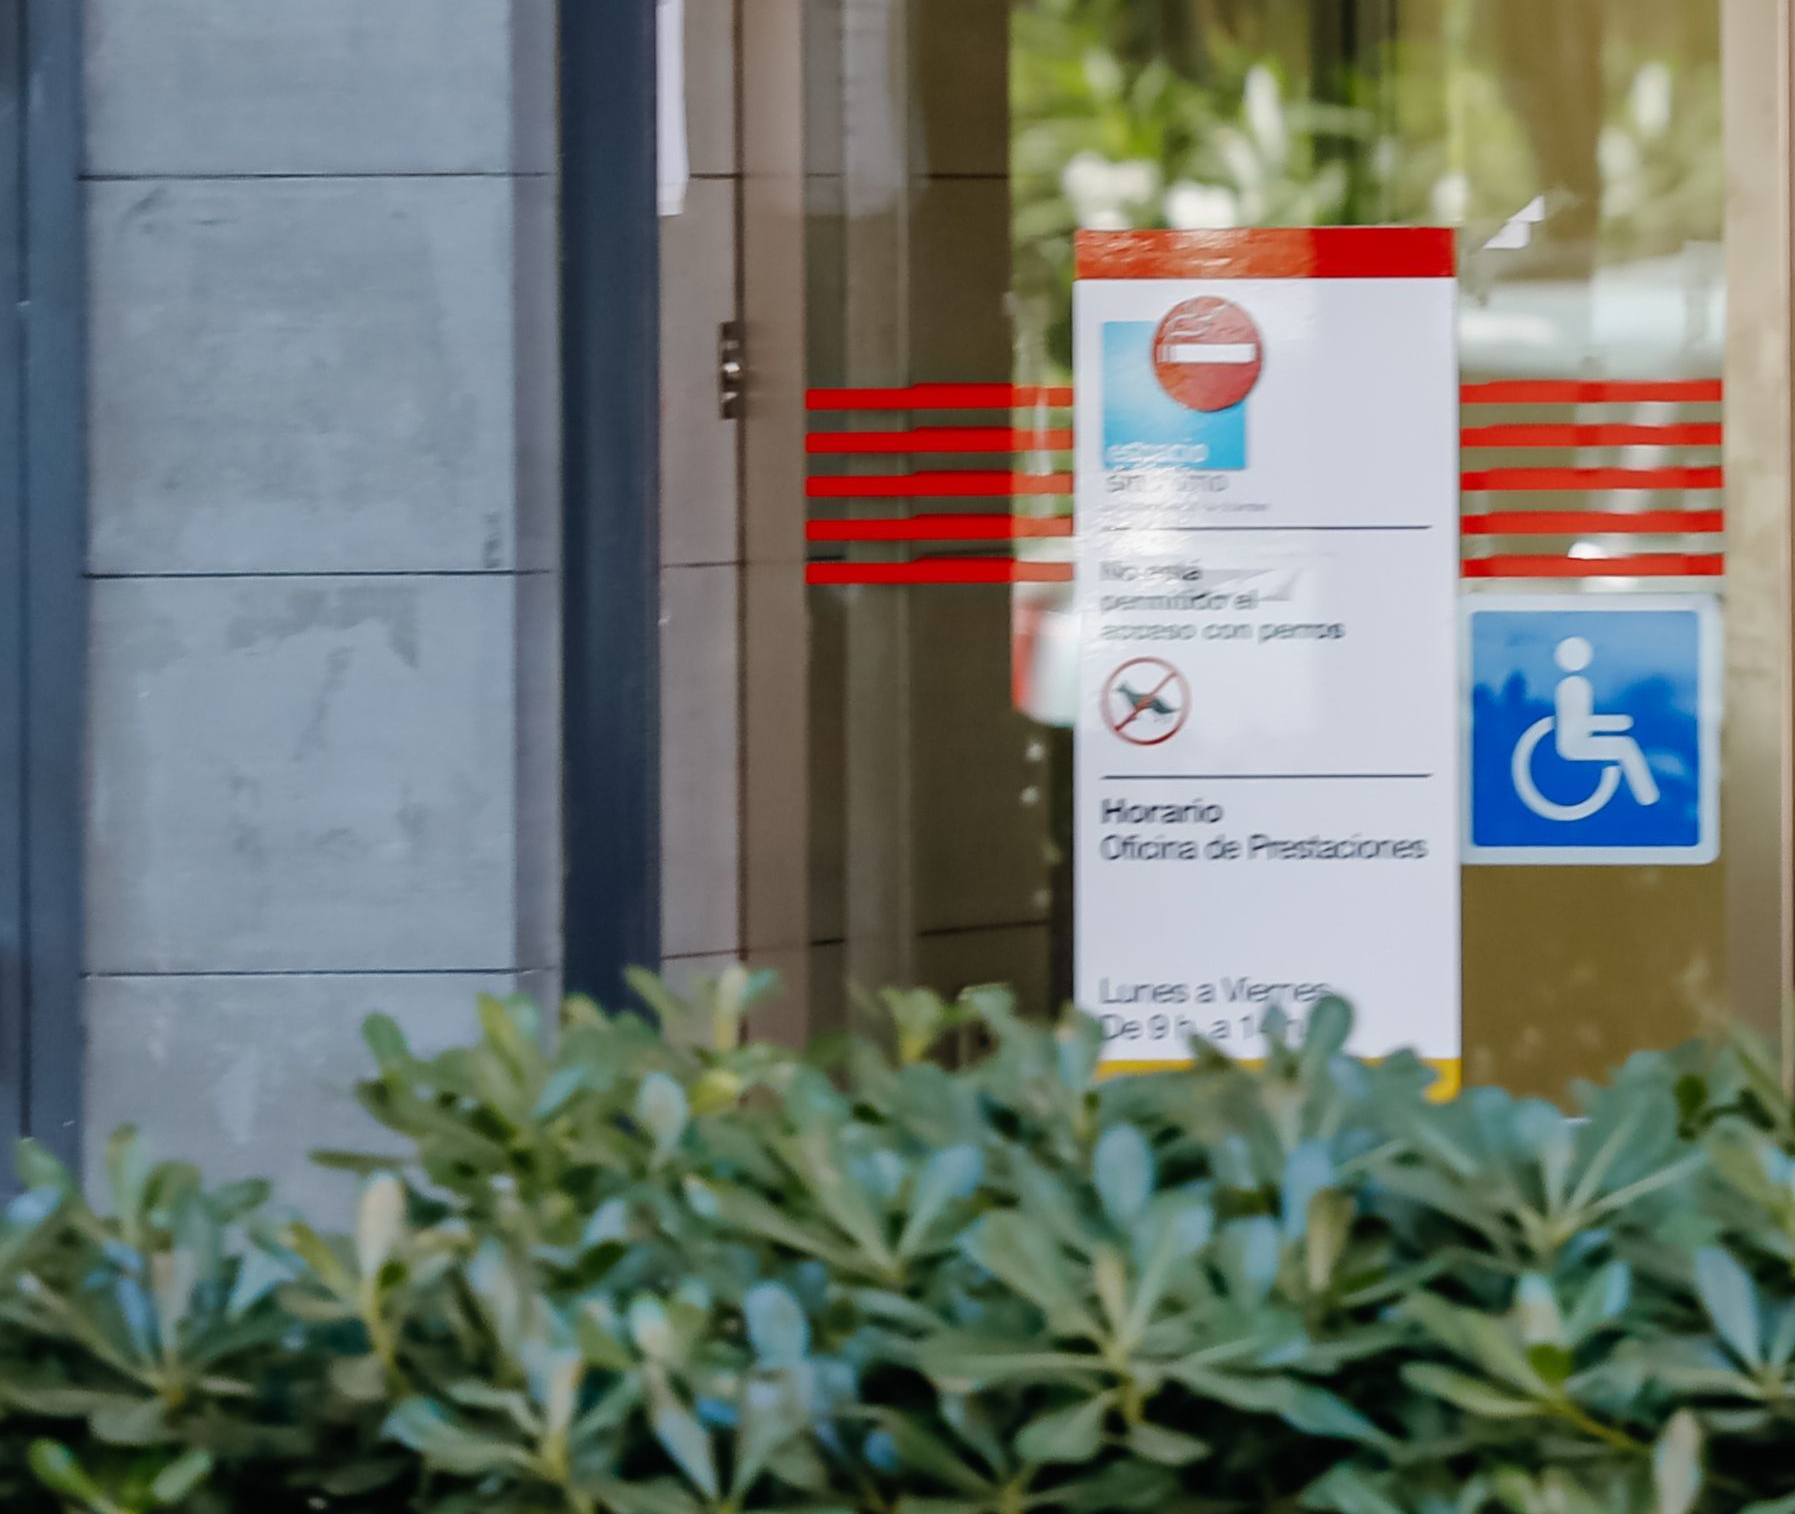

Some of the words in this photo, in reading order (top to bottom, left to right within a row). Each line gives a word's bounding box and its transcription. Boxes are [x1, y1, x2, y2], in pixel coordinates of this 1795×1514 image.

[1101, 622, 1197, 640] acceso
[1202, 622, 1252, 640] con
[1258, 622, 1346, 645] perros
[1101, 797, 1224, 824] Horario
[1100, 834, 1198, 861] Oficina
[1204, 834, 1242, 861] de
[1247, 833, 1429, 861] Prestaciones
[1100, 977, 1191, 1004] Lunes
[1196, 983, 1215, 1004] a
[1147, 1013, 1171, 1040] 9
